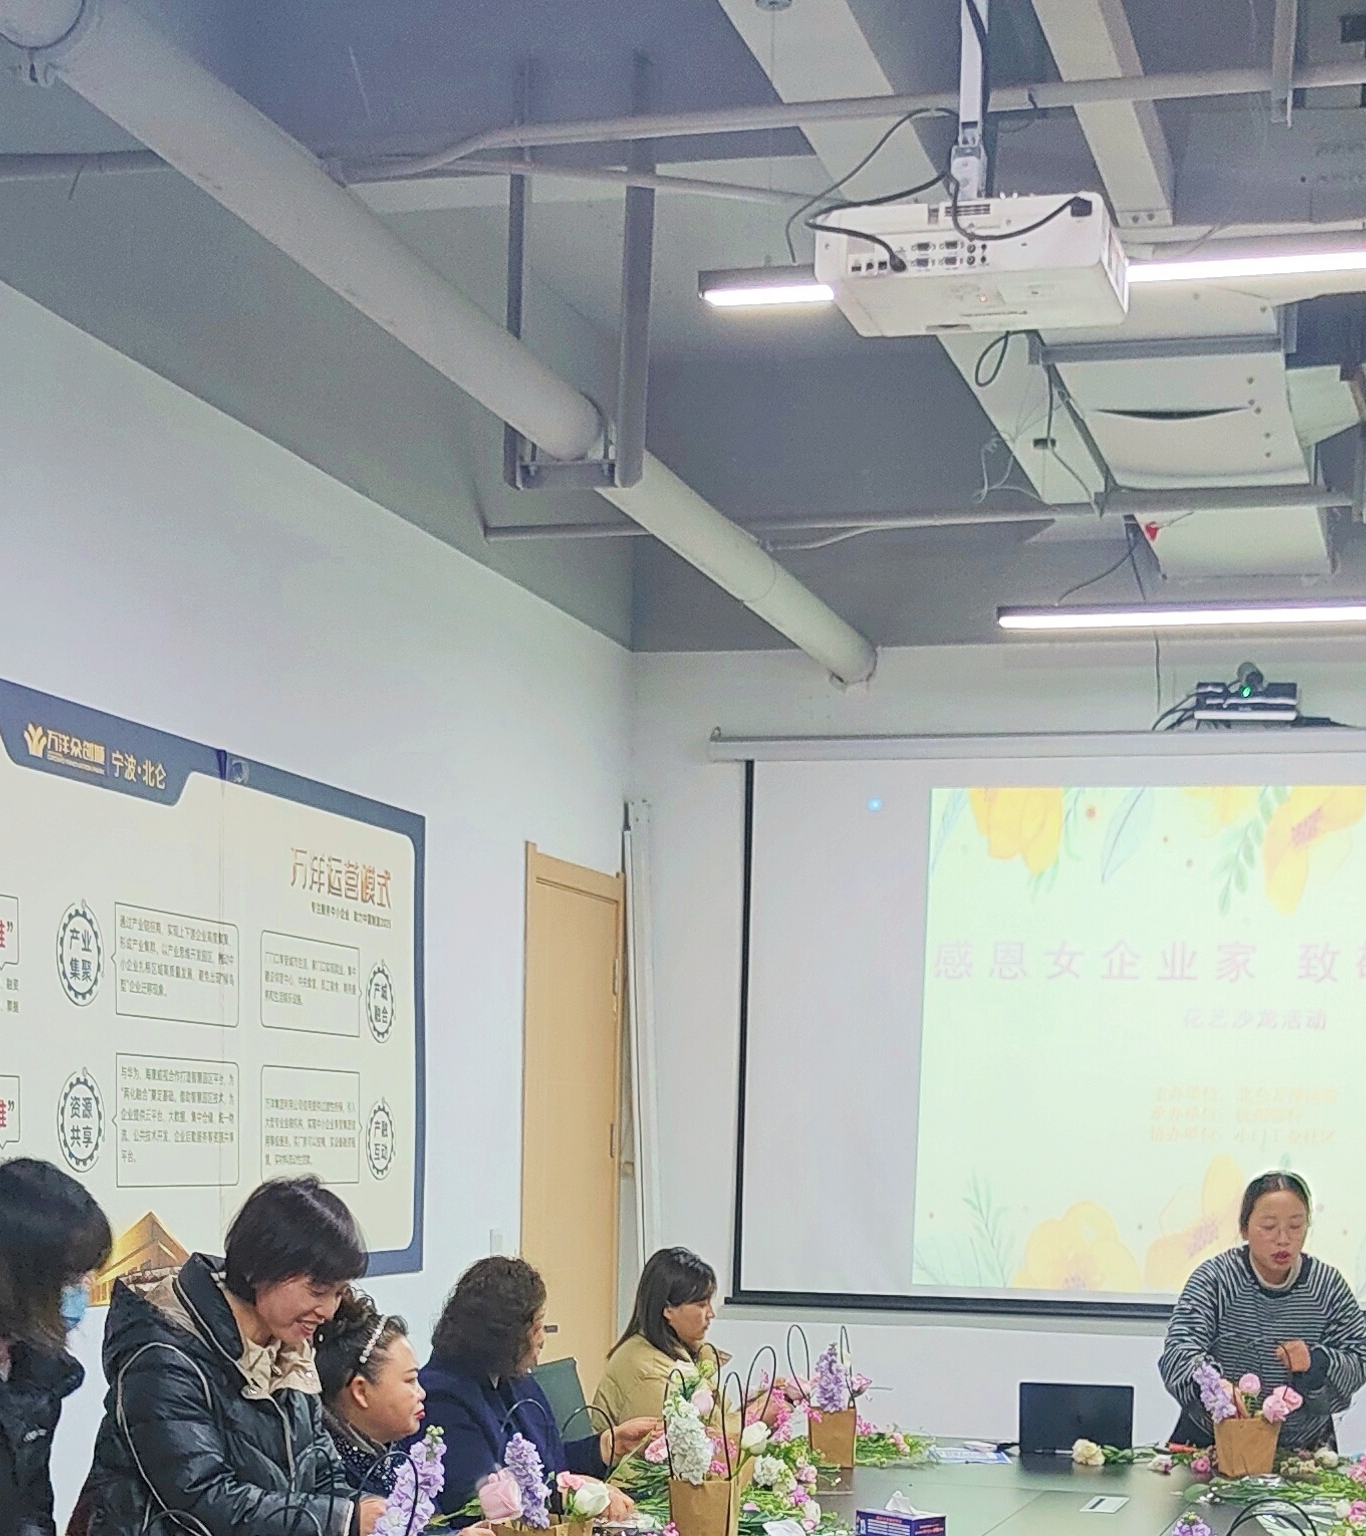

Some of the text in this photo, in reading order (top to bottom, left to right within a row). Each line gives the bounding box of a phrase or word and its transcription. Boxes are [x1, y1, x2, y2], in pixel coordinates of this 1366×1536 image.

[112, 750, 167, 790] 宁波·北仑
[290, 847, 392, 910] 万洋运营模式
[69, 927, 93, 953] 产业
[69, 957, 93, 983] 集聚
[934, 939, 1257, 983] 感恩女企业家
[1183, 1007, 1327, 1031] 花艺沙龙活动
[69, 1095, 93, 1119] 资源
[69, 1125, 93, 1148] 共享
